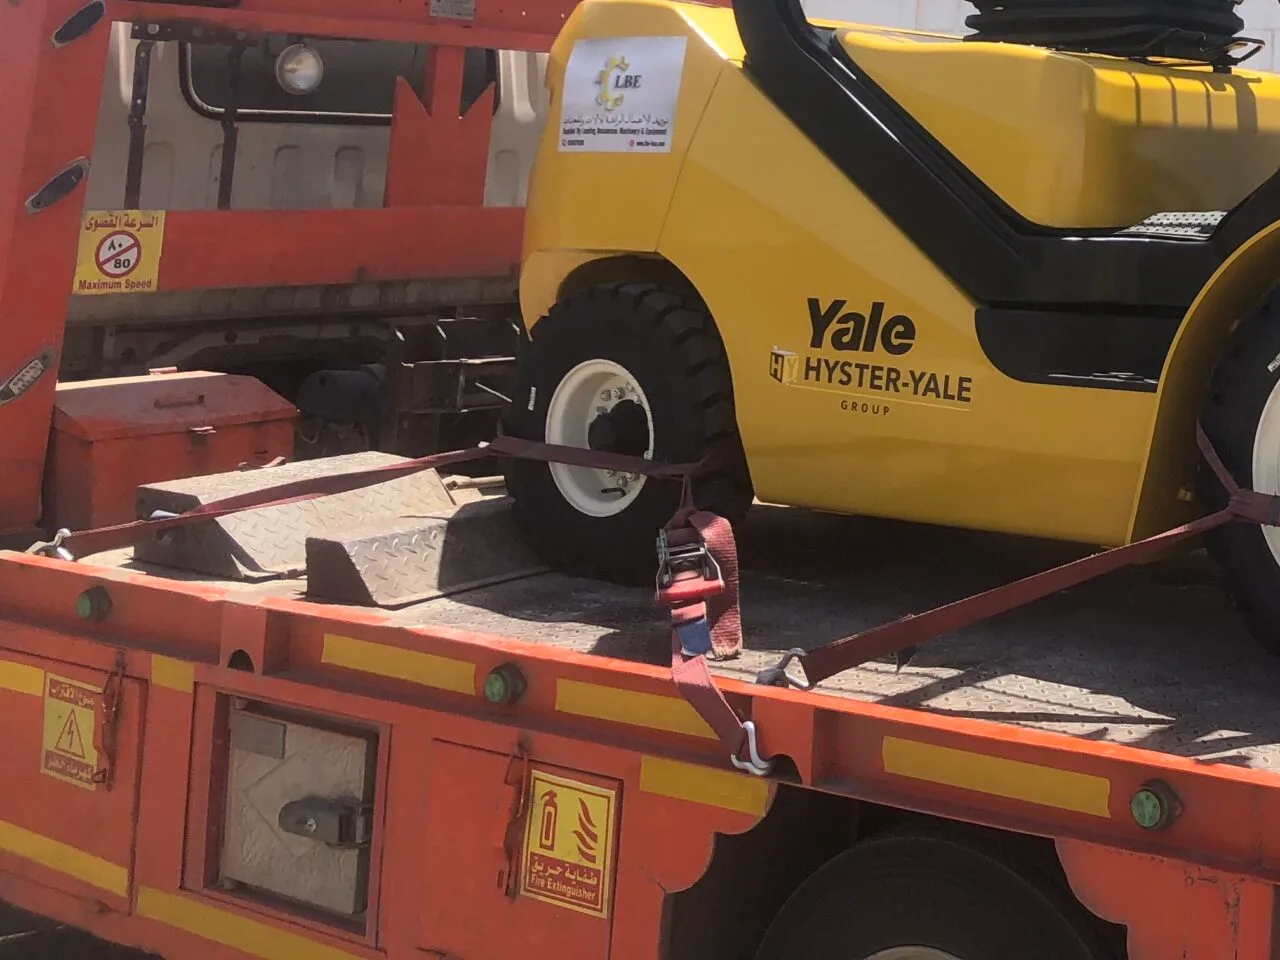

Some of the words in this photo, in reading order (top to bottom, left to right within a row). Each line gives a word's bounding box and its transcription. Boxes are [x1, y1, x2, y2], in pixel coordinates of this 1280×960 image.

[614, 74, 642, 89] LBE
[85, 214, 122, 232] القصوى
[124, 213, 159, 232] السرعة
[108, 239, 122, 251] ٨٠
[113, 258, 131, 269] 80
[79, 279, 122, 290] Maximum
[124, 278, 152, 290] Speed
[807, 298, 916, 355] Yale
[804, 356, 973, 402] HYSTER-YALE
[840, 400, 890, 416] GROUP
[531, 856, 563, 876] حريق
[565, 863, 598, 885] طفاية
[531, 873, 546, 888] Fire
[547, 878, 596, 900] Extinguisher
